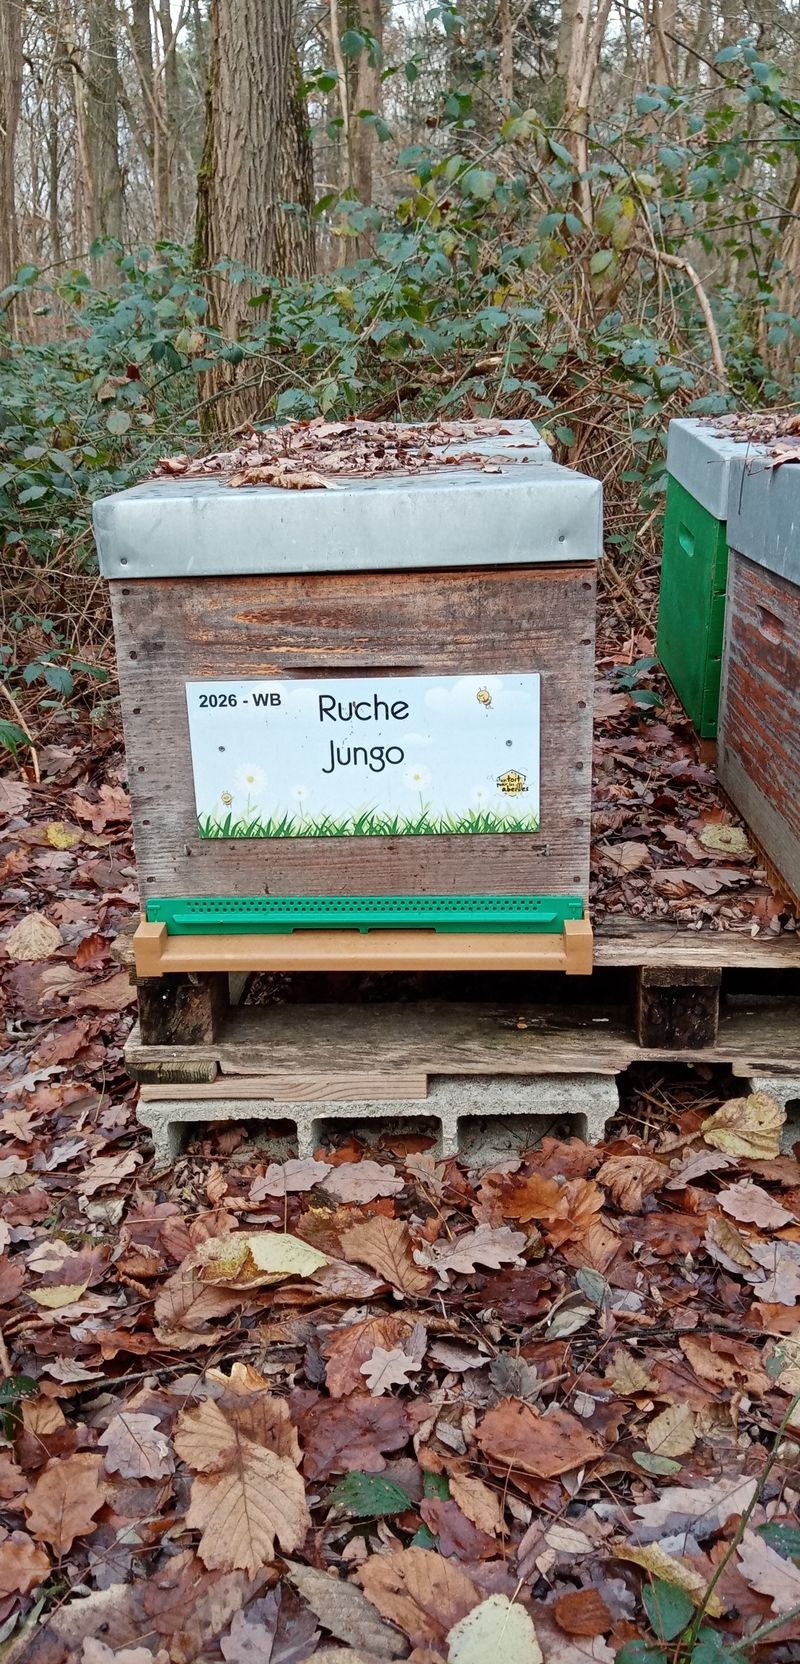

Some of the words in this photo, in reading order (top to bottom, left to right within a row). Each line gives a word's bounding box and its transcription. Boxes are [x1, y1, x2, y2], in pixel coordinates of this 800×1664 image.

[198, 693, 238, 708] 2026
[253, 693, 282, 707] WB
[318, 693, 410, 722] Ruche
[321, 739, 405, 774] Jungo
